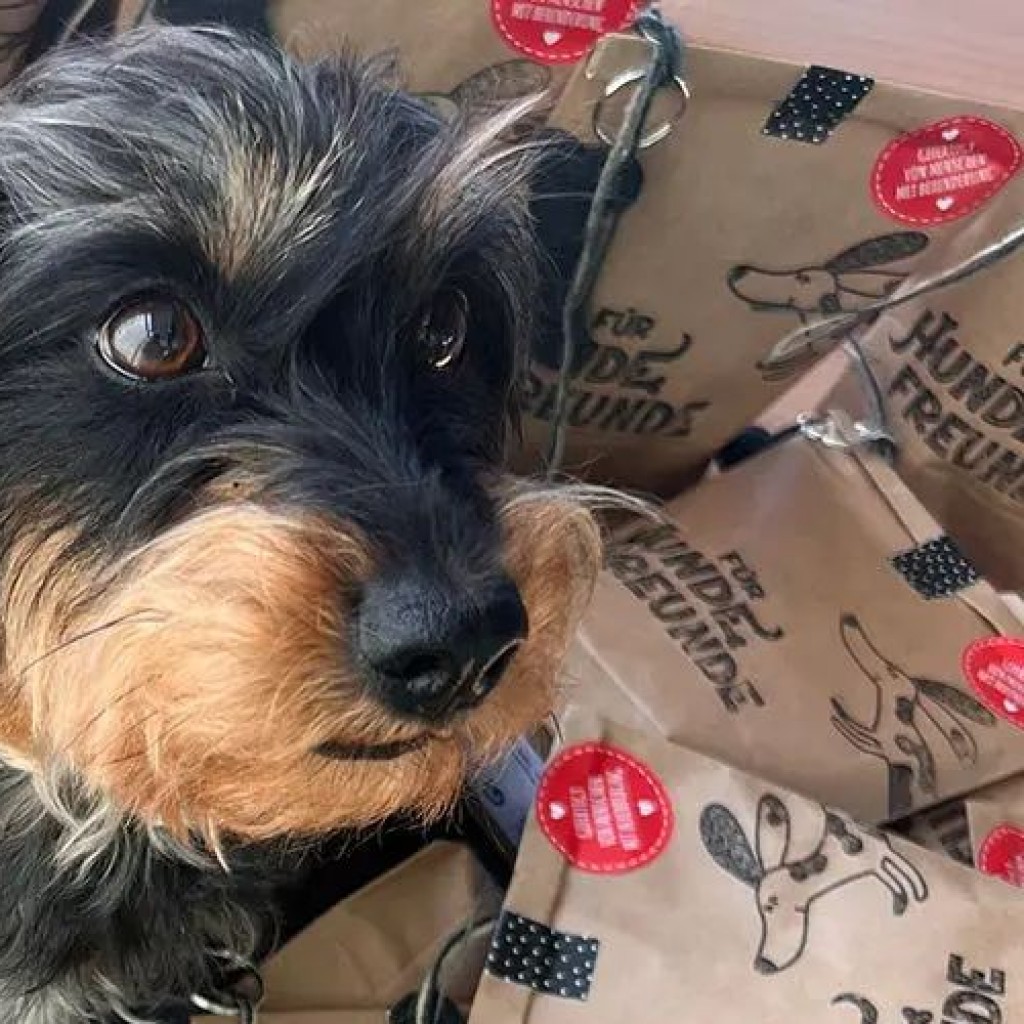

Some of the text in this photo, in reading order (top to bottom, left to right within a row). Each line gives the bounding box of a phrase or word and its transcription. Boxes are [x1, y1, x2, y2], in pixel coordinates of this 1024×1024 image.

[591, 308, 654, 340] FÜR
[889, 310, 1024, 442] HUND
[889, 362, 1024, 501] FREUN
[606, 548, 765, 713] REUNDE
[718, 550, 766, 598] FÜR
